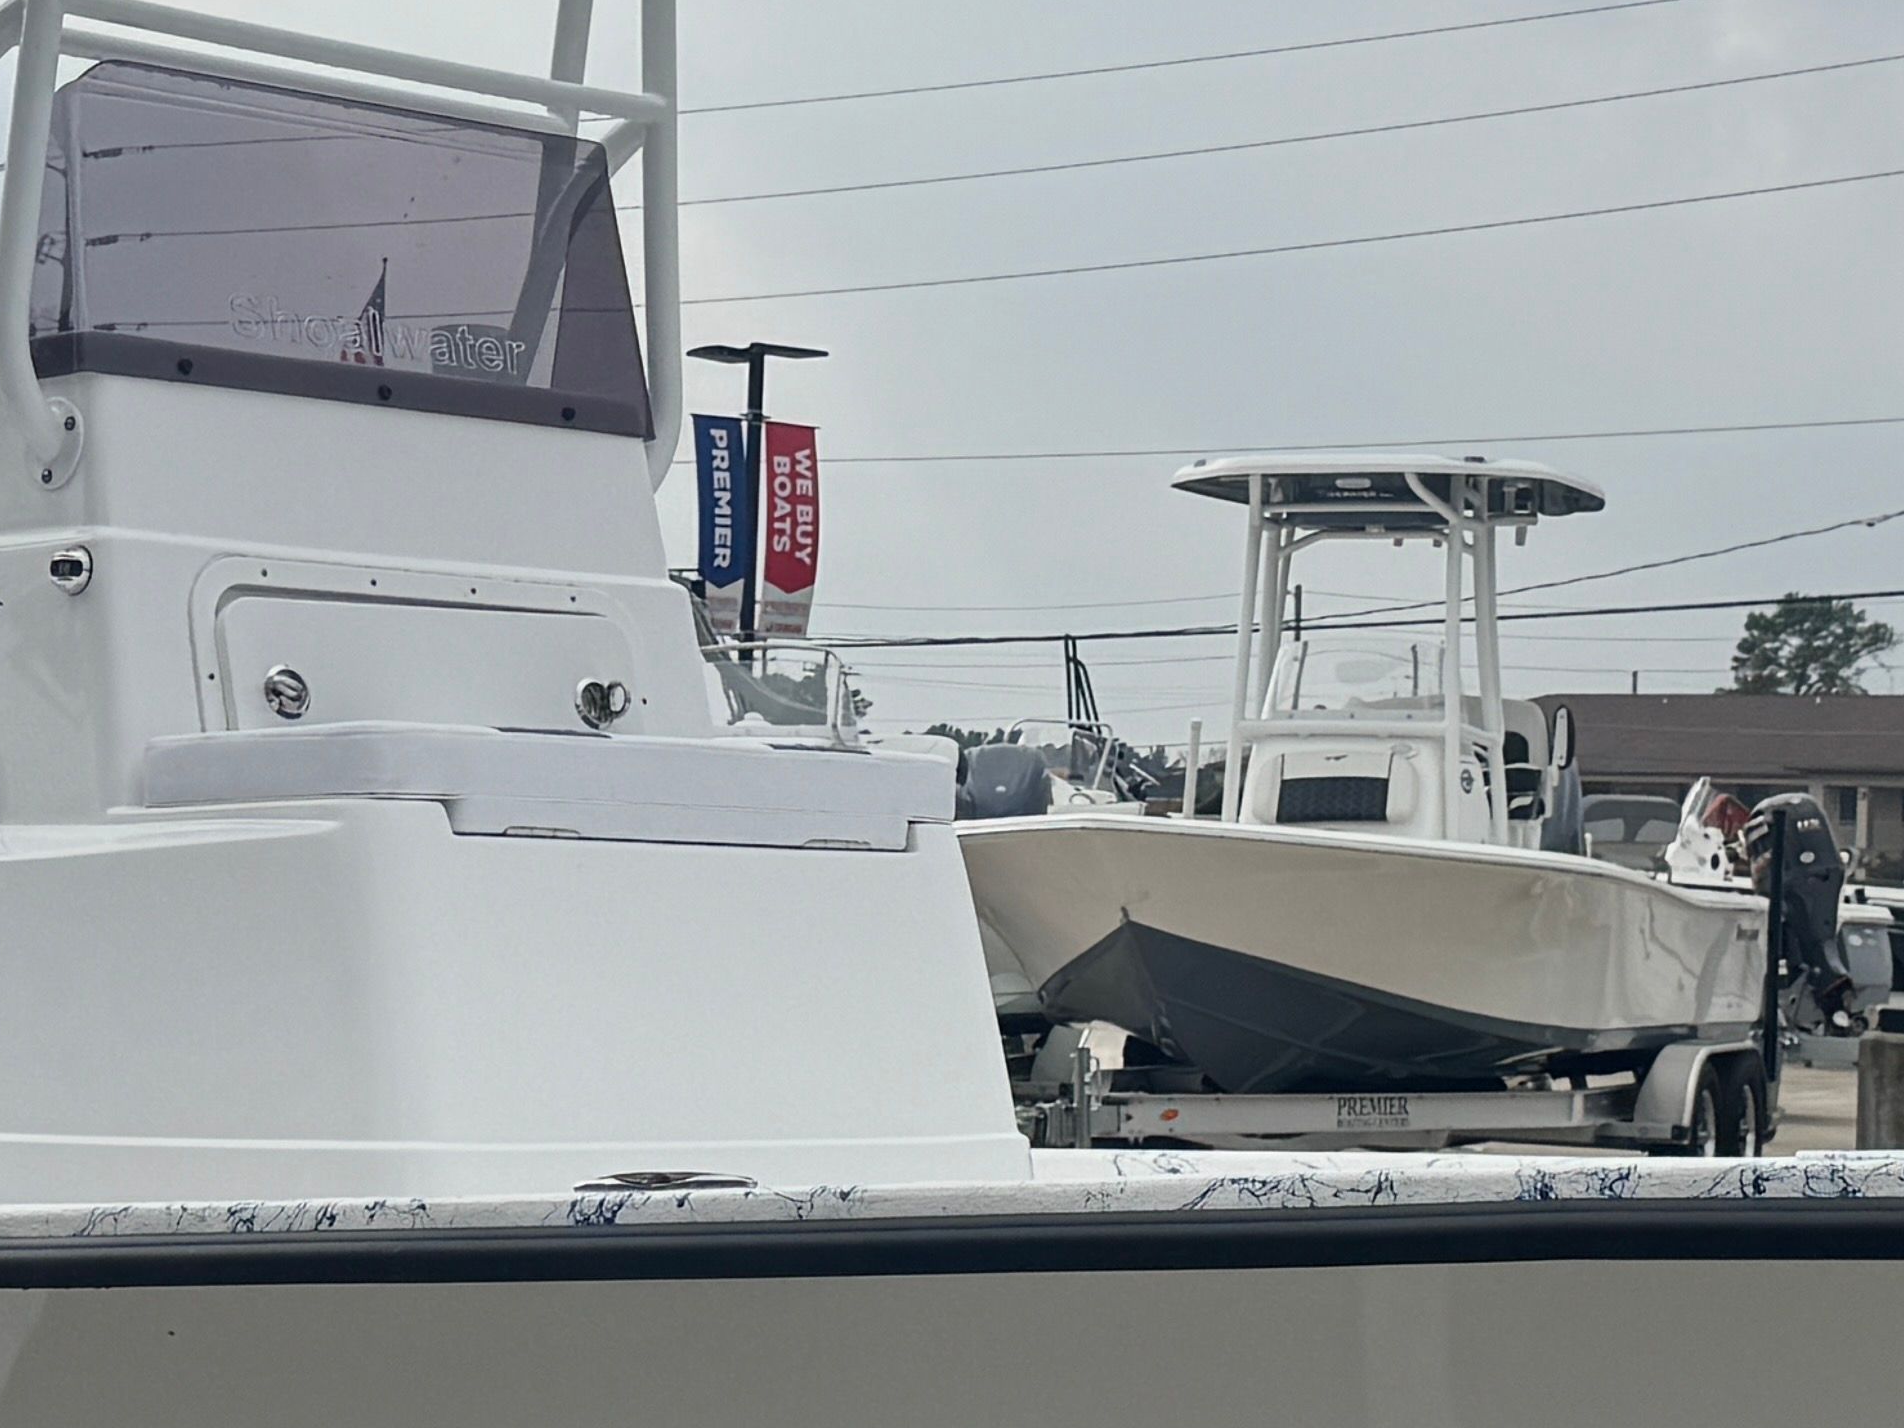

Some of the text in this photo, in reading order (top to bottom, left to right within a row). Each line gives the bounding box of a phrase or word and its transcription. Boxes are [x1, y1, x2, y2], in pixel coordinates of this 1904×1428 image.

[228, 291, 526, 375] Shoalwater
[709, 428, 732, 569] PREMIER
[772, 455, 792, 553] BOATS
[794, 448, 814, 566] WE BUY
[1337, 1095, 1409, 1117] PREMIER
